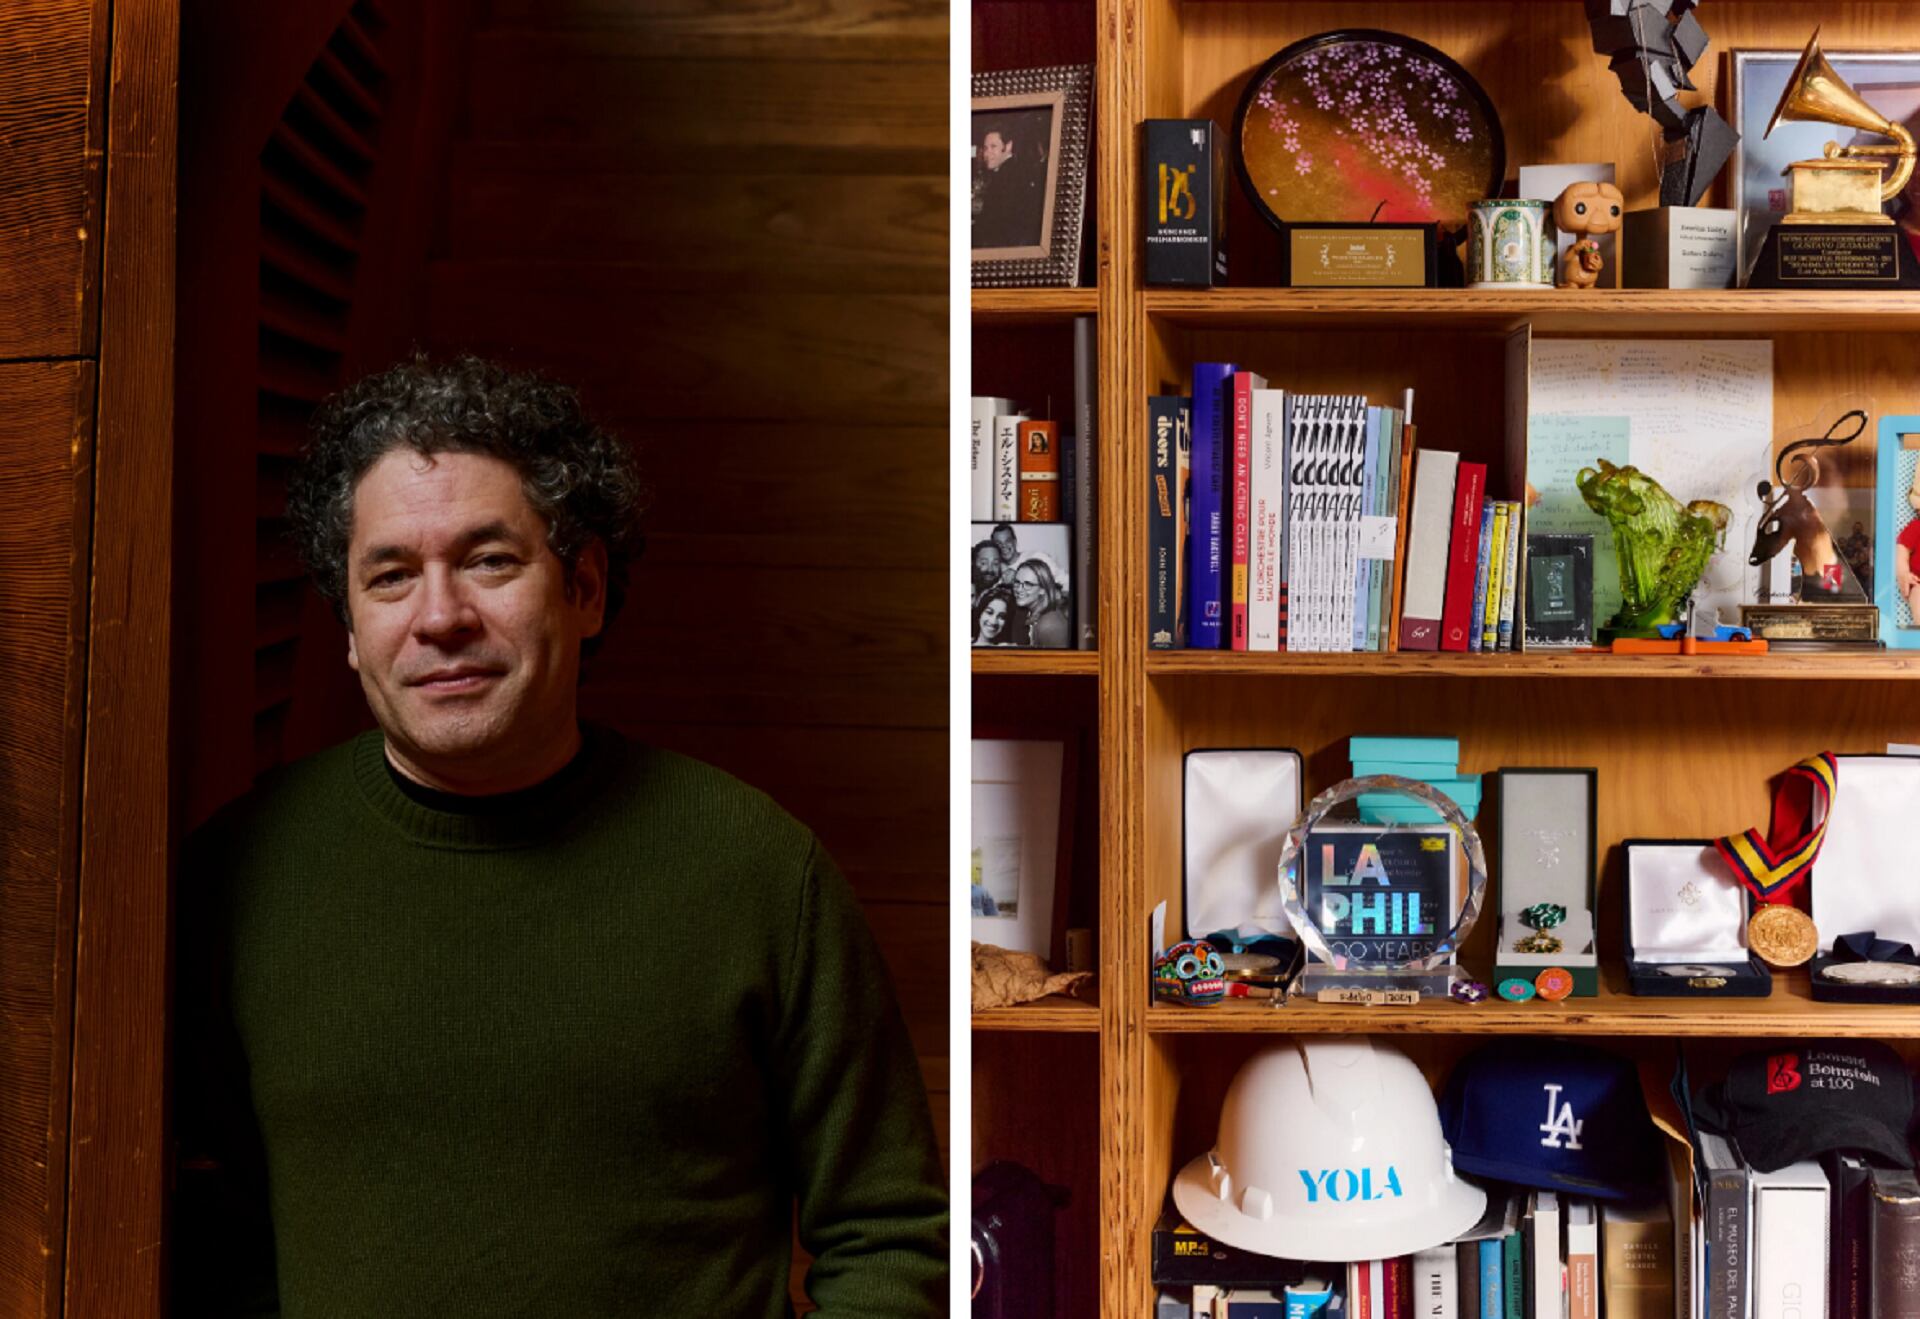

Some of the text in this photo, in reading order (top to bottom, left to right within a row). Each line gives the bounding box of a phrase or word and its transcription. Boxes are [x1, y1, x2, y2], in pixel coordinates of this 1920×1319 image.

[1237, 398, 1247, 430] DON'T
[1157, 415, 1173, 468] doors
[1237, 463, 1246, 476] AN
[1236, 481, 1246, 518] ACTING
[1236, 523, 1245, 556] CLASS
[1257, 528, 1266, 585] ORCHESTRE
[1321, 843, 1391, 887] LA
[1321, 892, 1434, 935] PHIL
[1373, 941, 1434, 960] YEARS
[1807, 1049, 1867, 1068] Leonard
[1808, 1063, 1880, 1087] Bernstein
[1810, 1075, 1854, 1091] at 100
[1540, 1083, 1583, 1150] LA
[1299, 1165, 1403, 1202] YOLA
[1728, 1207, 1738, 1220] EL
[1727, 1224, 1738, 1266] MUSEO
[1431, 1273, 1442, 1298] THE
[1727, 1269, 1738, 1292] DEL
